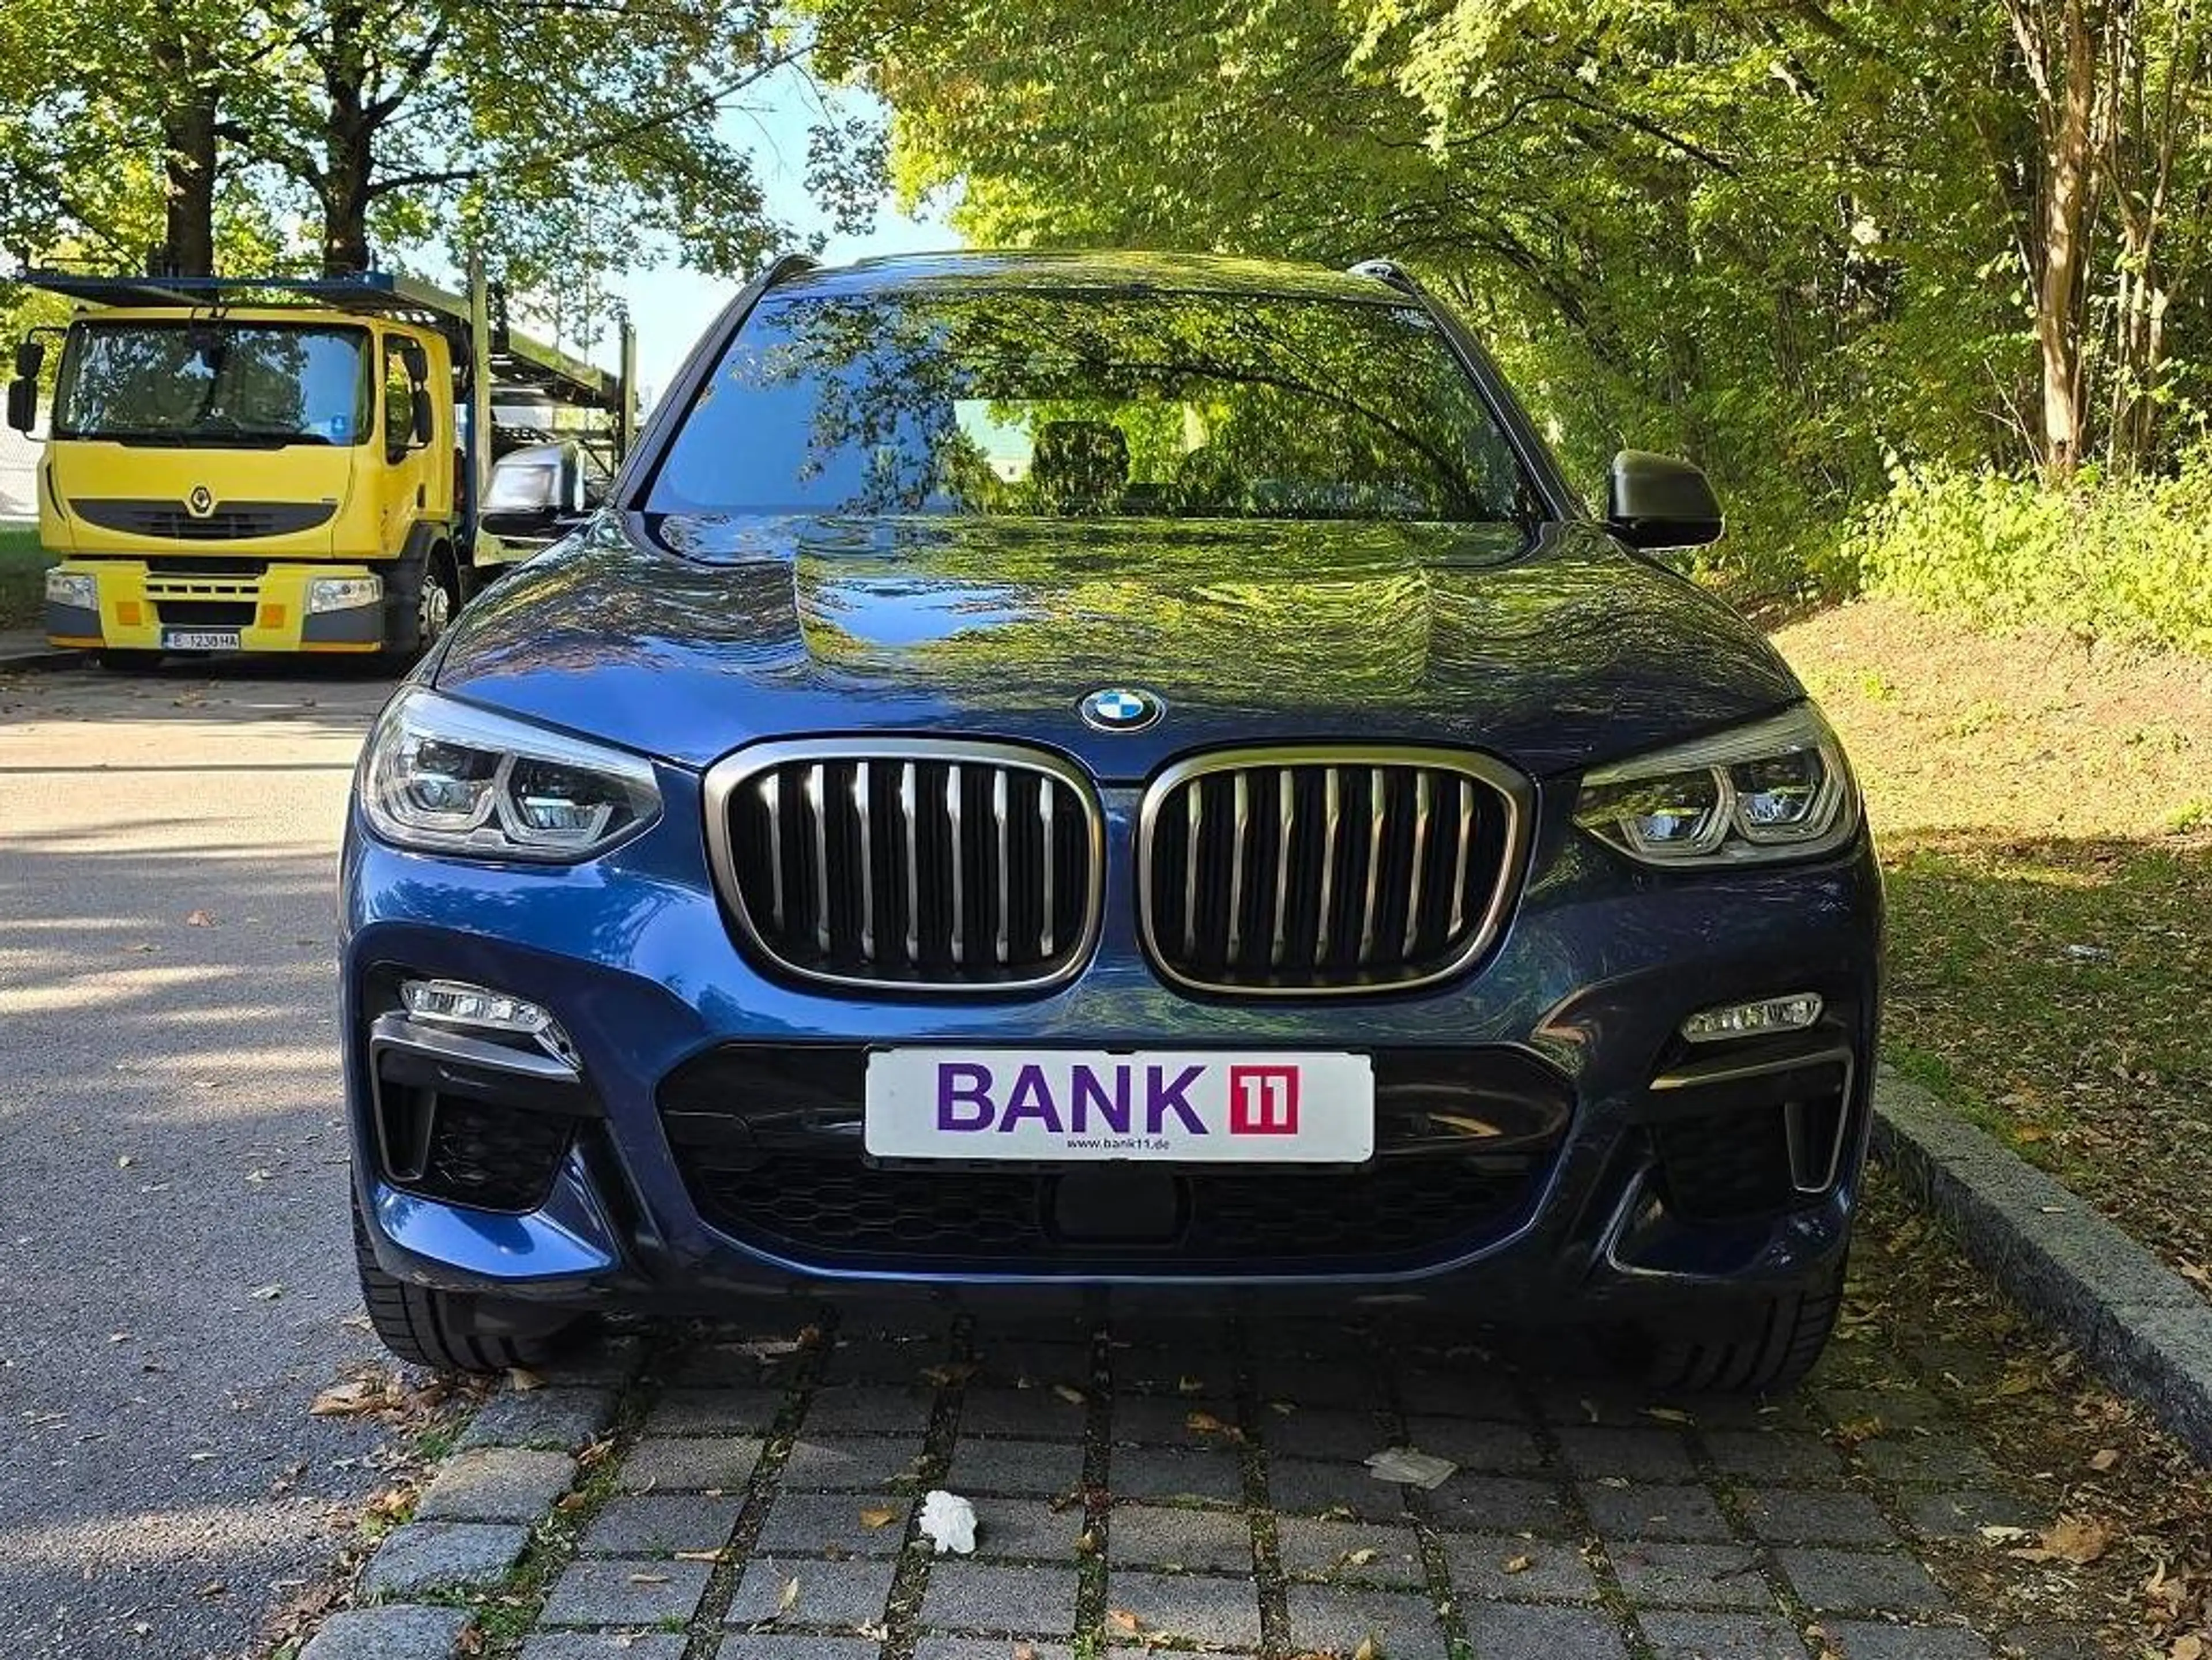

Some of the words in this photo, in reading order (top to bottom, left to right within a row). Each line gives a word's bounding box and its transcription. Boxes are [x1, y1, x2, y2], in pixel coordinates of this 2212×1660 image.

[937, 1063, 1209, 1134] BANK
[1239, 1076, 1286, 1126] 11
[1067, 1138, 1170, 1150] www.bank11.de
